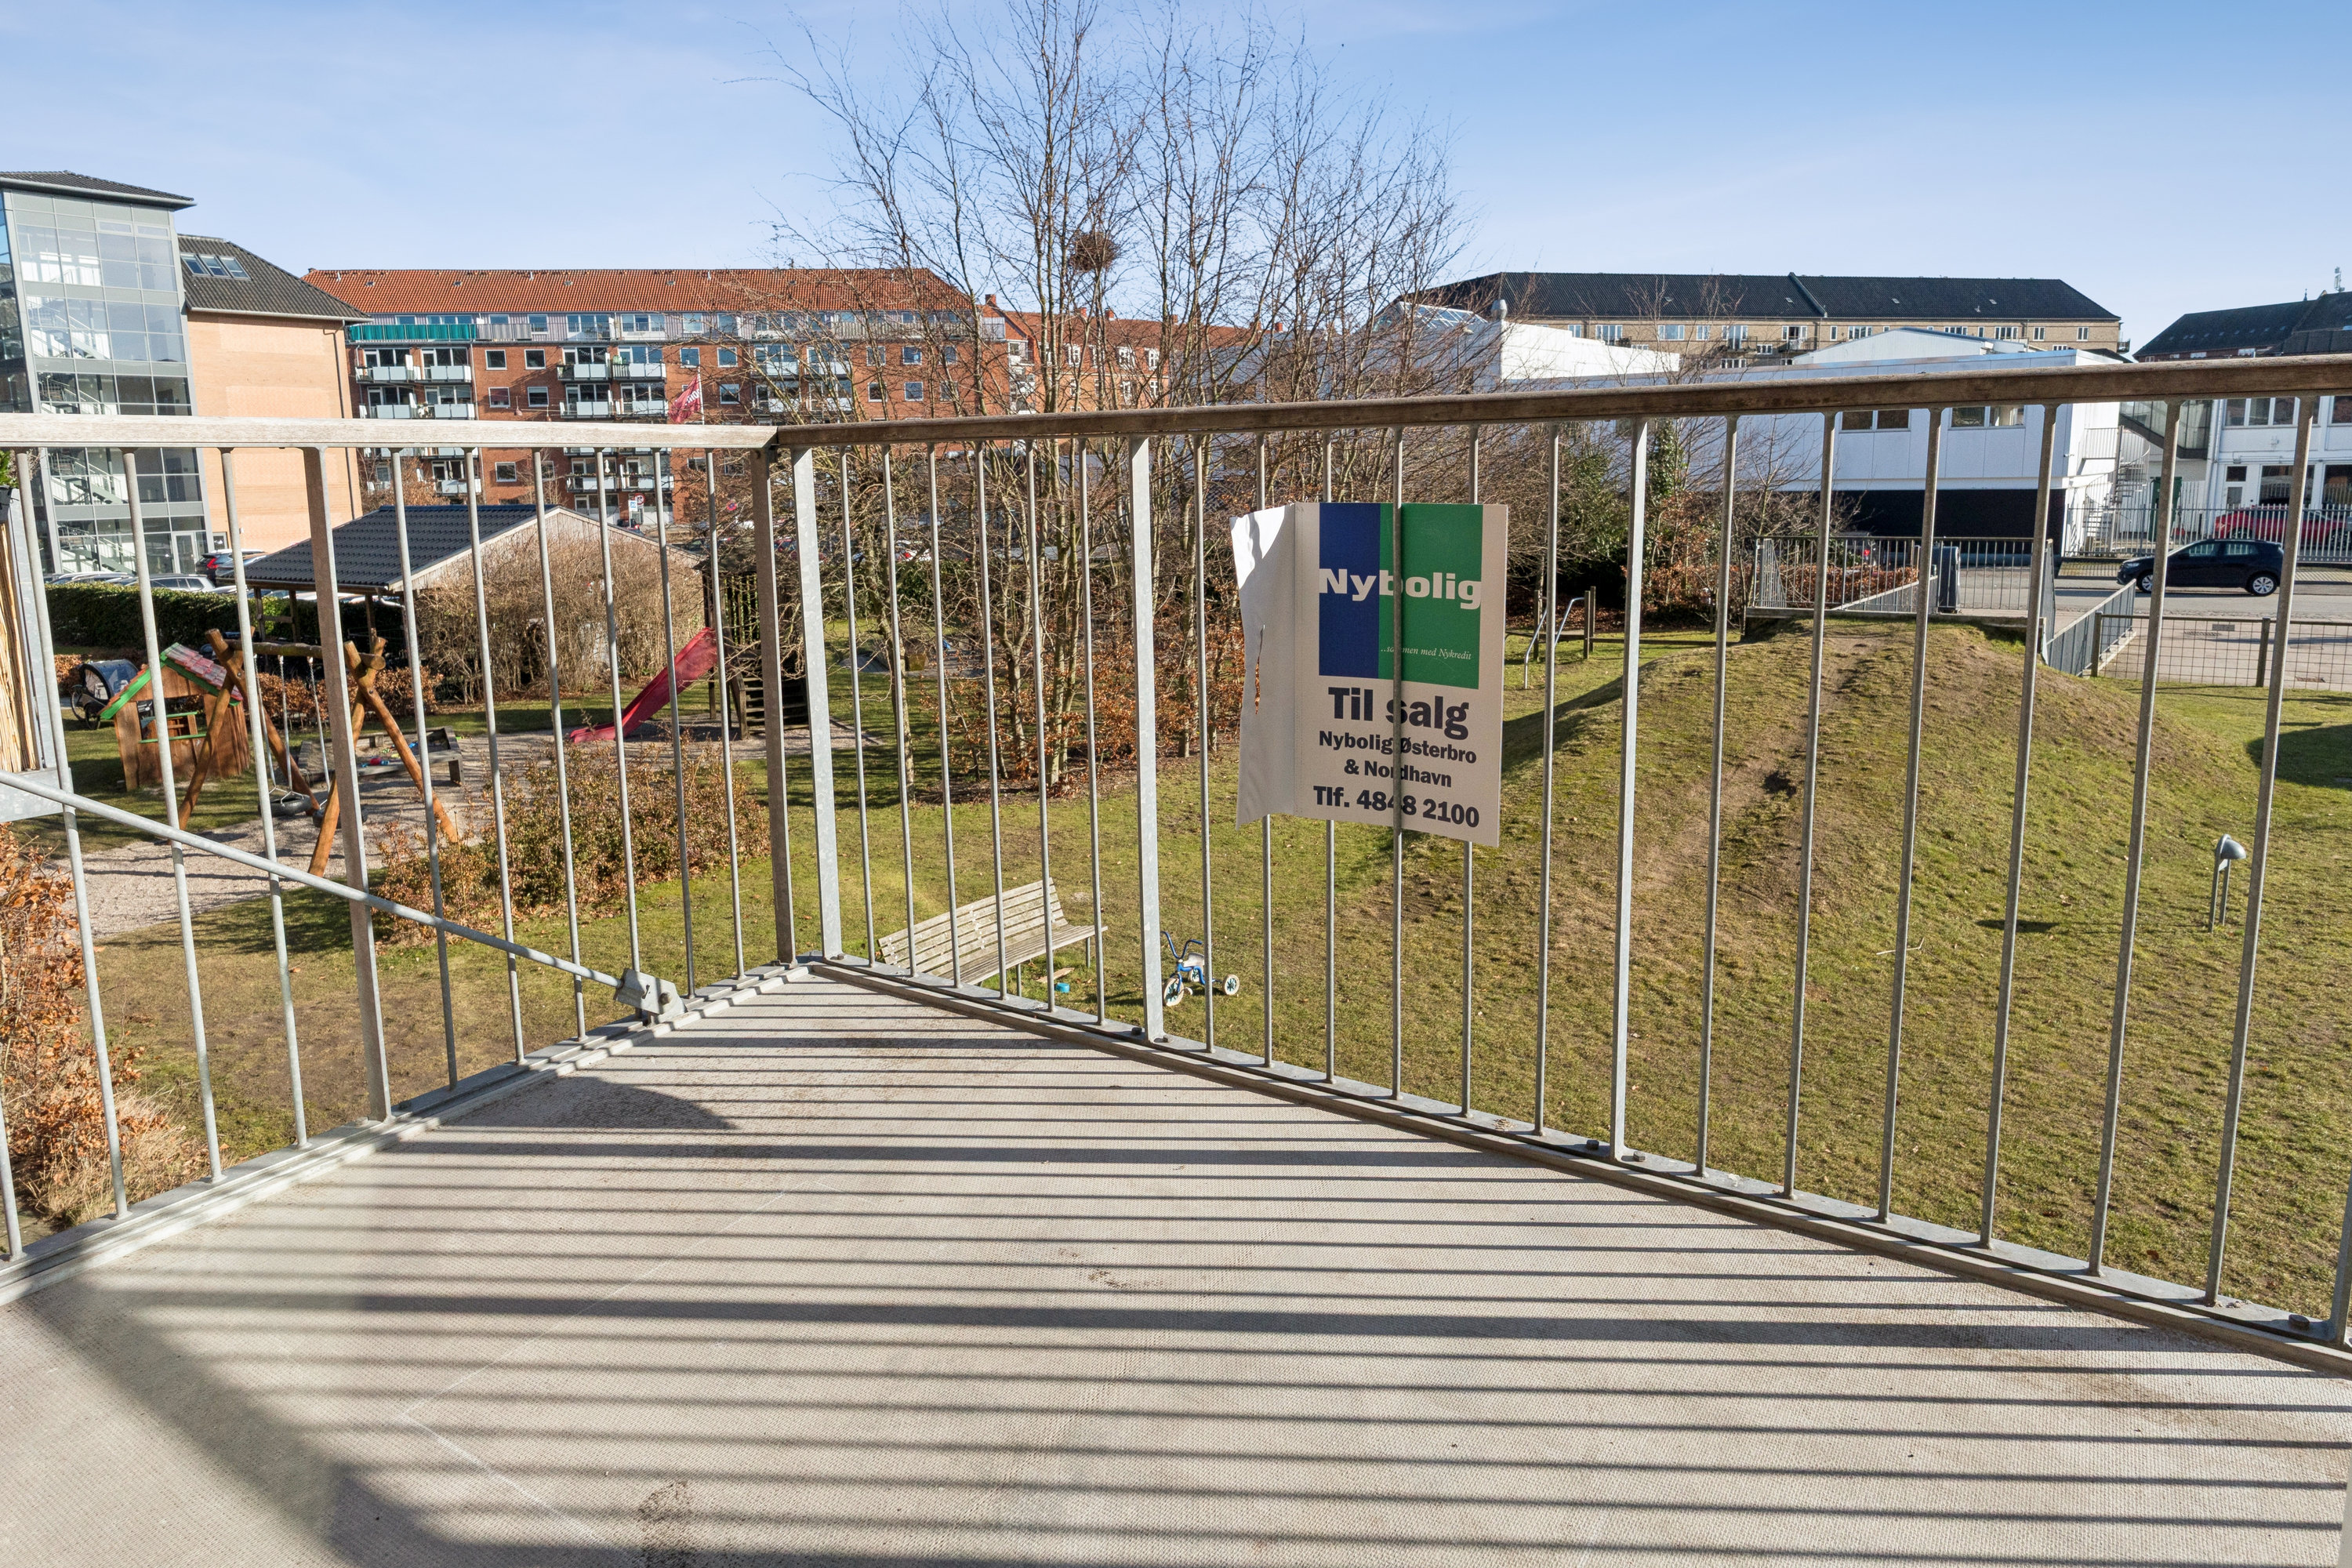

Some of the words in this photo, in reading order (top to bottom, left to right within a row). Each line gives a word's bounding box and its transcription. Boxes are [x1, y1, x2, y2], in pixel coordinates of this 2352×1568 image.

[1319, 568, 1482, 610] Nybolig
[1381, 646, 1418, 655] ..samen
[1421, 648, 1437, 657] med
[1439, 648, 1472, 660] Nykredit
[1328, 687, 1374, 721] Til
[1385, 695, 1469, 740] salg
[1319, 731, 1394, 755] Nybolig
[1399, 737, 1477, 764] Østerbro
[1344, 759, 1359, 775] &
[1313, 786, 1350, 808] Tlf.
[1422, 798, 1480, 828] 2100
